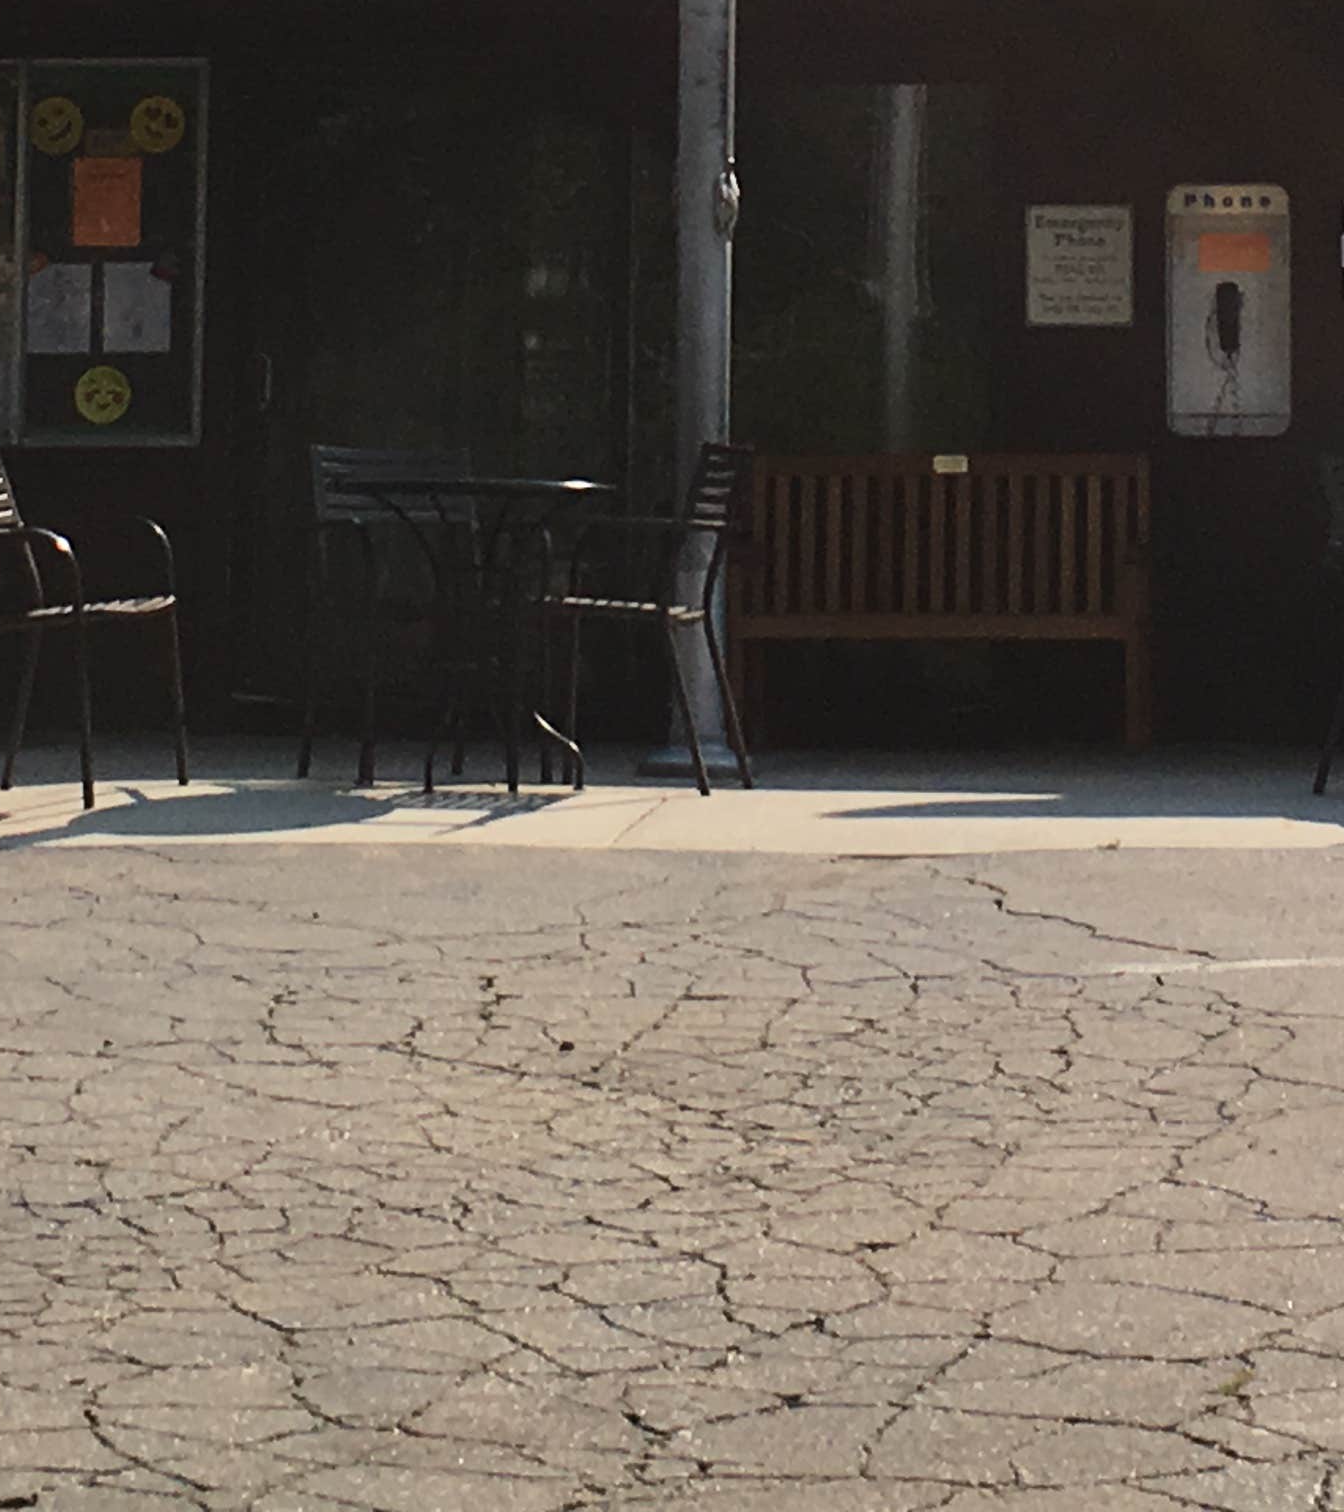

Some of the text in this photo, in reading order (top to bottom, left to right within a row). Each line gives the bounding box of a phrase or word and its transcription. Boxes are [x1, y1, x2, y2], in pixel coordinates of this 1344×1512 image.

[1183, 193, 1272, 209] Phone
[1034, 215, 1126, 234] Emergency
[1054, 232, 1107, 247] Phone
